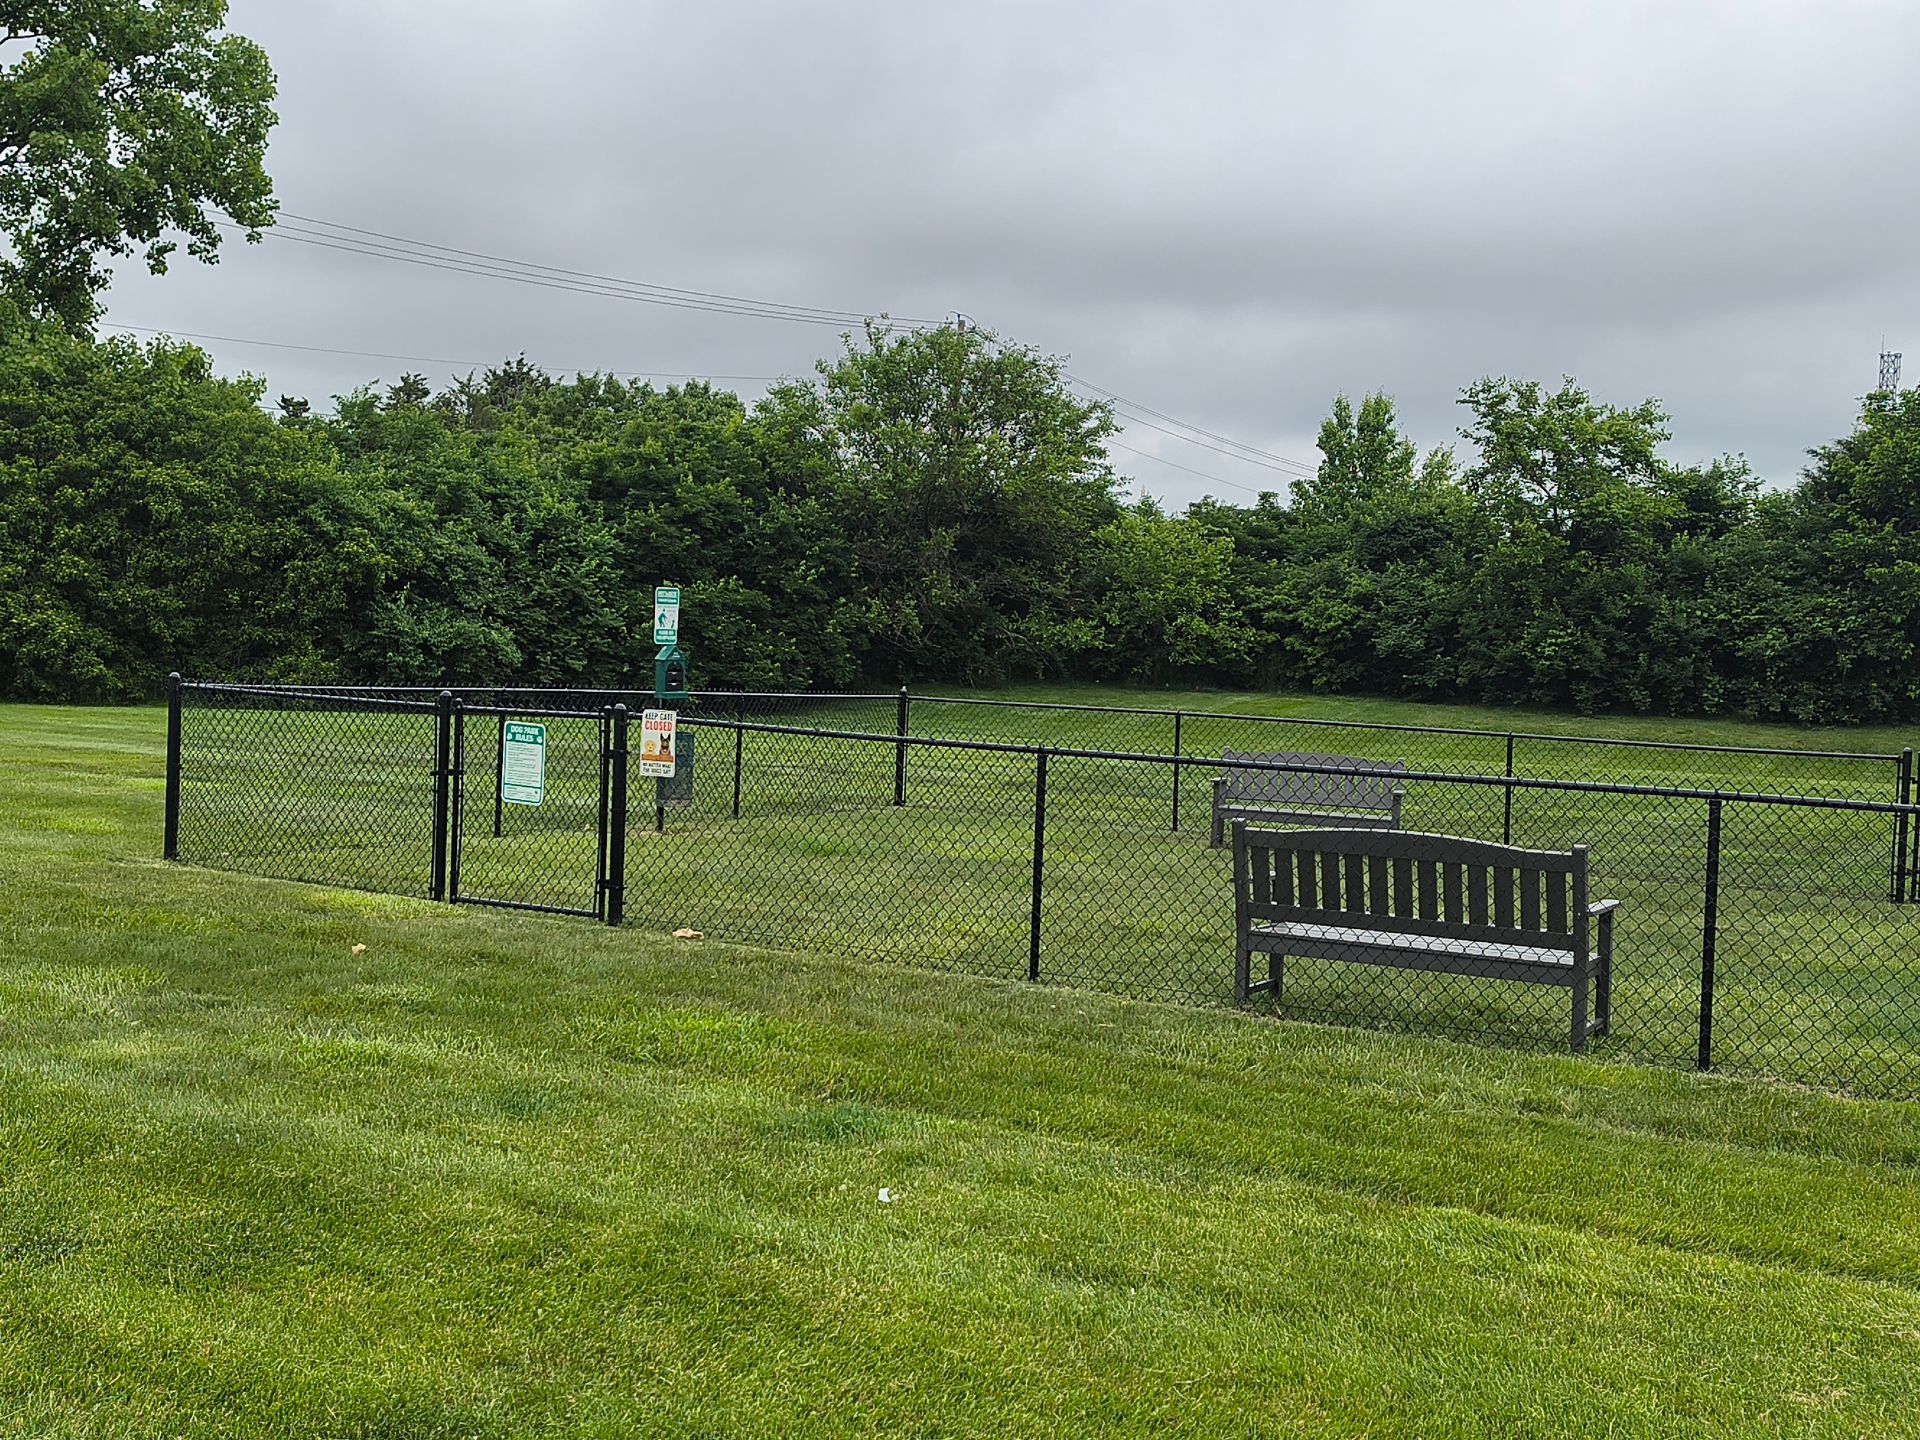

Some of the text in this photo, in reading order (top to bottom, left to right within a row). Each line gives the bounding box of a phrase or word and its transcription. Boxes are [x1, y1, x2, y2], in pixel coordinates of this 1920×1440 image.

[660, 713, 673, 721] GATE
[511, 725, 539, 735] DOG PARK
[645, 720, 672, 731] CLOSED
[515, 733, 534, 742] RULES
